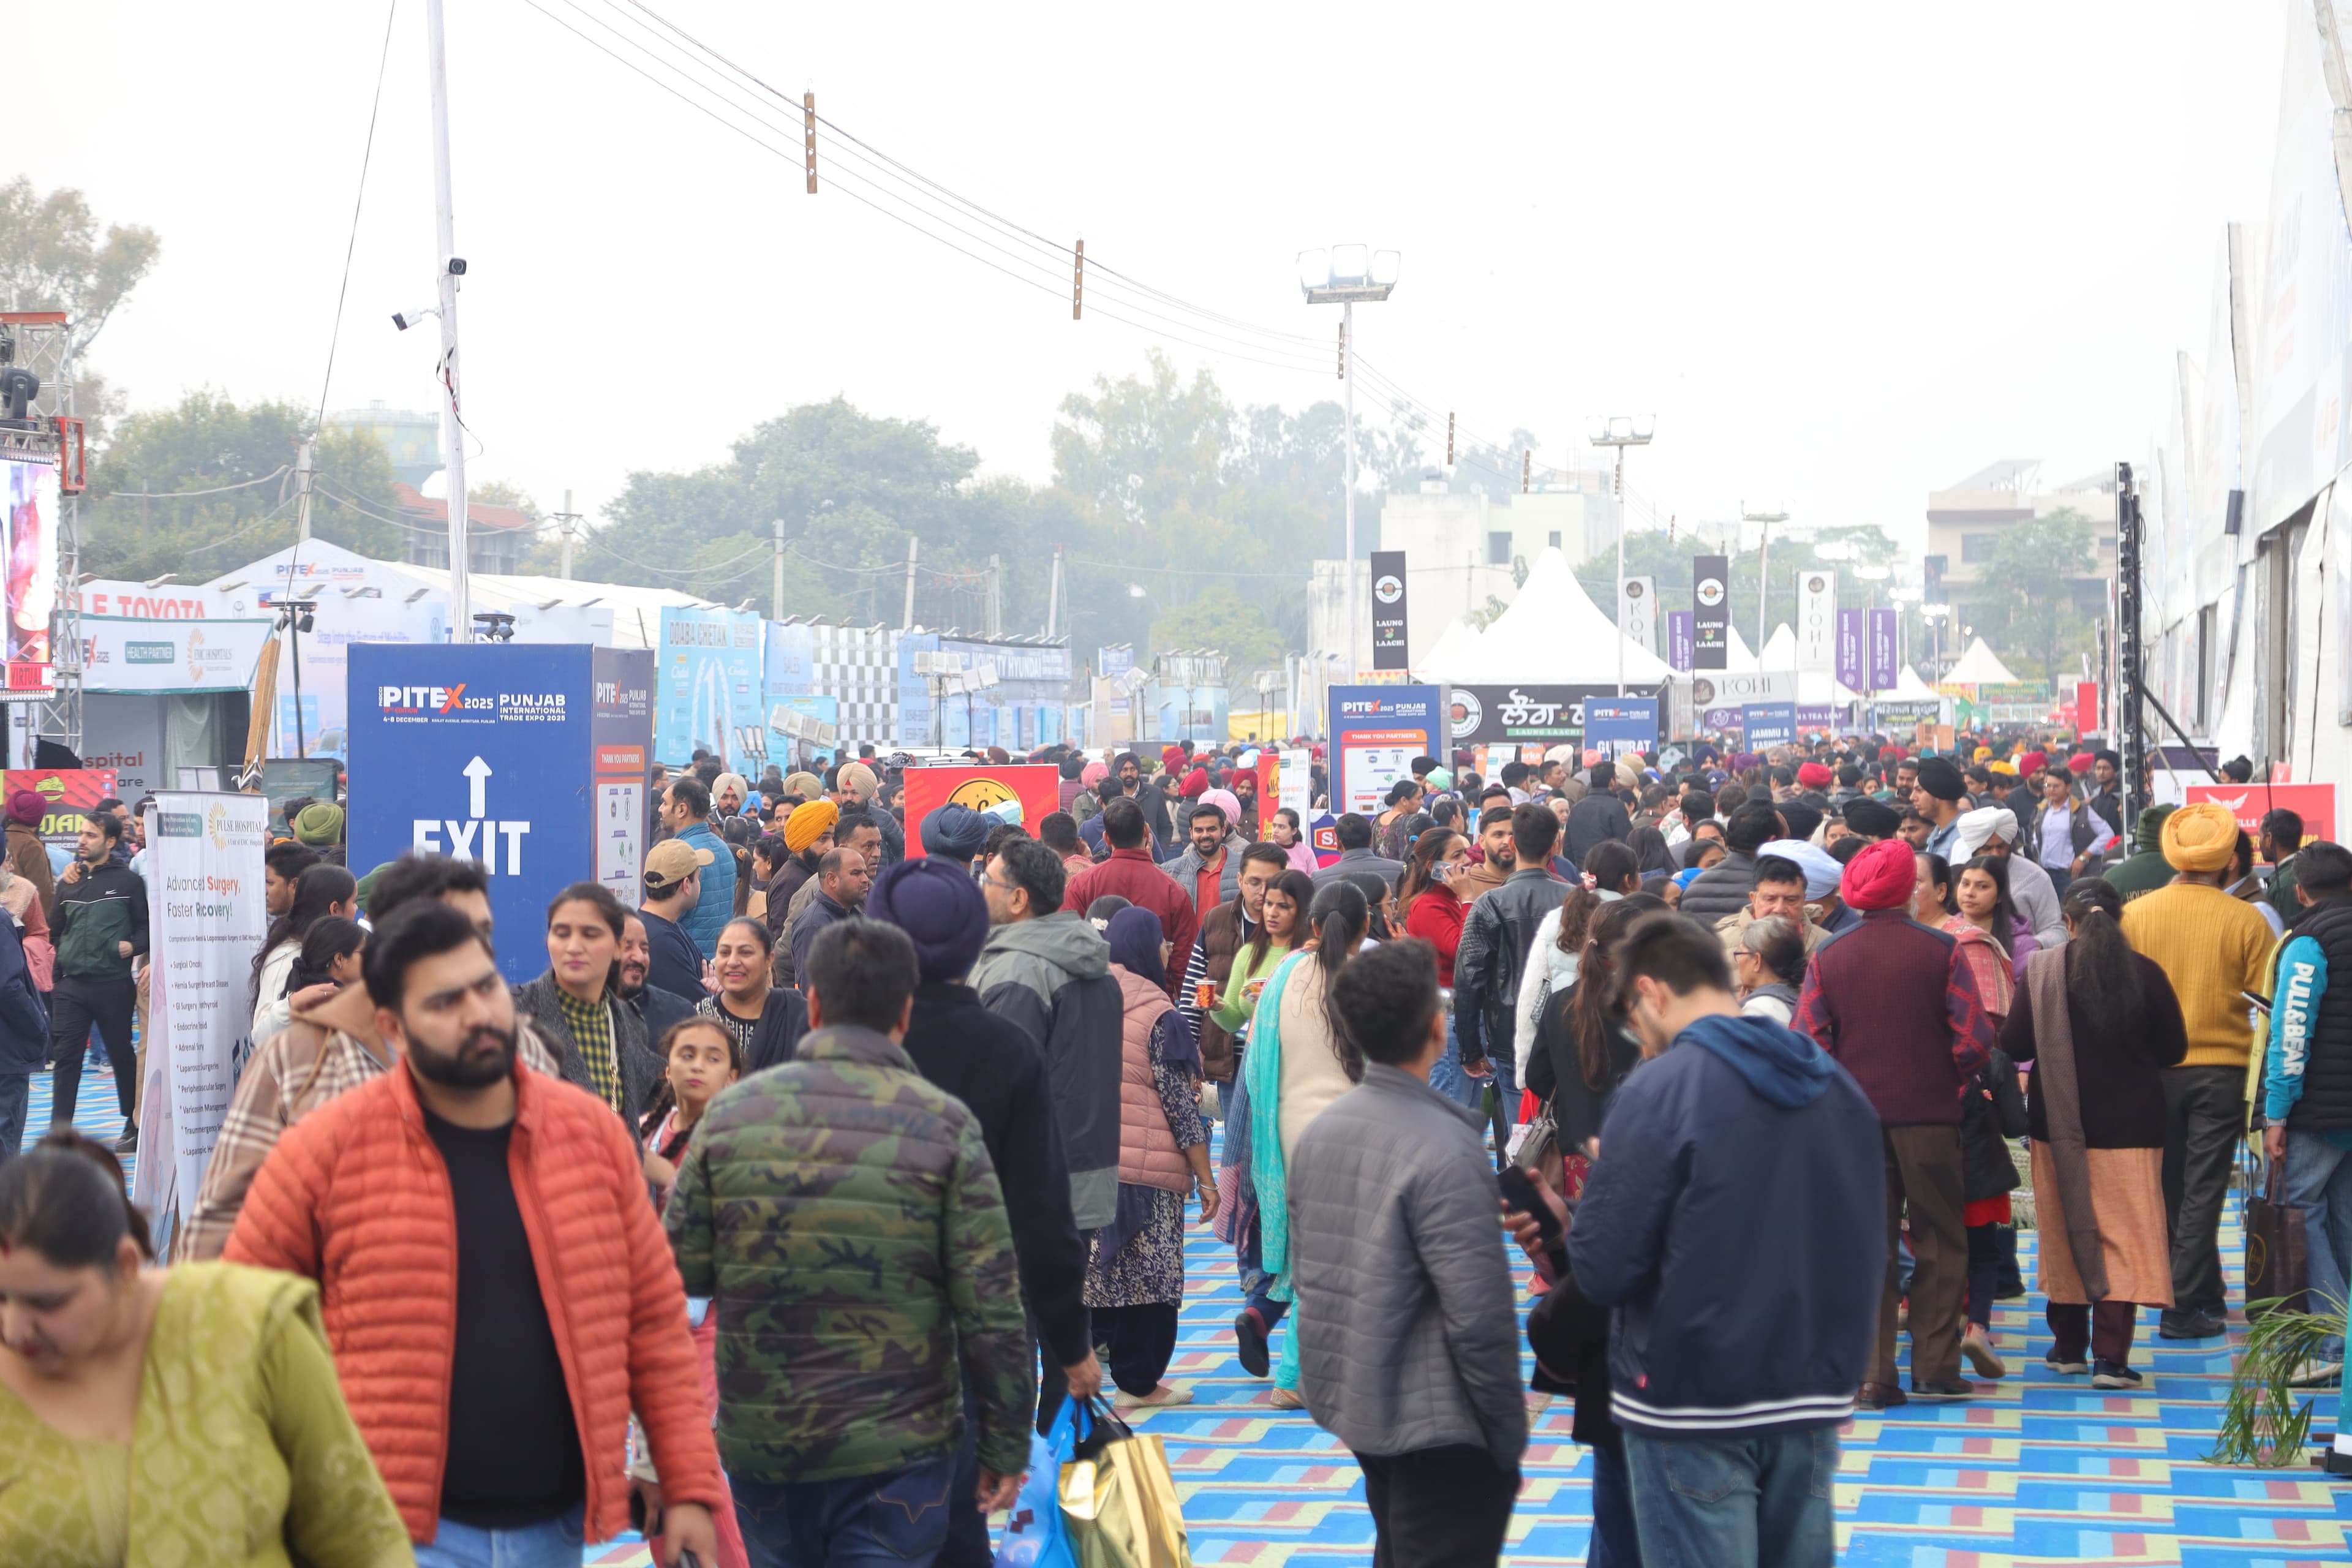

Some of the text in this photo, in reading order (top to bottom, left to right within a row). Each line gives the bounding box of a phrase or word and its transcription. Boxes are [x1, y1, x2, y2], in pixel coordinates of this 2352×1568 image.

[277, 562, 316, 577] PITEX
[118, 596, 205, 619] TOYOTA
[1809, 597, 1823, 659] KOHI
[126, 646, 173, 660] HEALTH PARTNER
[1009, 655, 1042, 678] HYUNDAI
[1170, 656, 1221, 678] NOVELTY TATA
[1722, 676, 1771, 696] KOHI
[383, 684, 494, 714] PITEX 2025
[500, 695, 566, 706] PUNJAB
[597, 679, 628, 709] PITEX 2025
[629, 689, 647, 701] PUNJAB
[1344, 699, 1382, 715] PITEX
[1594, 707, 1620, 718] PITEX
[1751, 728, 1781, 739] JAMMU
[1597, 739, 1652, 755] GURAT
[83, 752, 143, 769] spital
[601, 754, 613, 763] THANK
[622, 753, 639, 763] PARTNERS
[117, 778, 144, 787] are
[217, 820, 263, 833] PULSE HOSPITAL
[2236, 818, 2257, 827] ELLE
[413, 820, 530, 875] EXIT
[208, 876, 240, 896] Surgery,
[168, 902, 192, 917] Faster
[173, 960, 188, 970] Surgical
[175, 981, 187, 989] Hernia
[181, 1002, 197, 1011] Surgery
[177, 1022, 197, 1031] Endocrine
[2283, 962, 2315, 1076] PULL&BEAR
[179, 1042, 195, 1051] Adrenal
